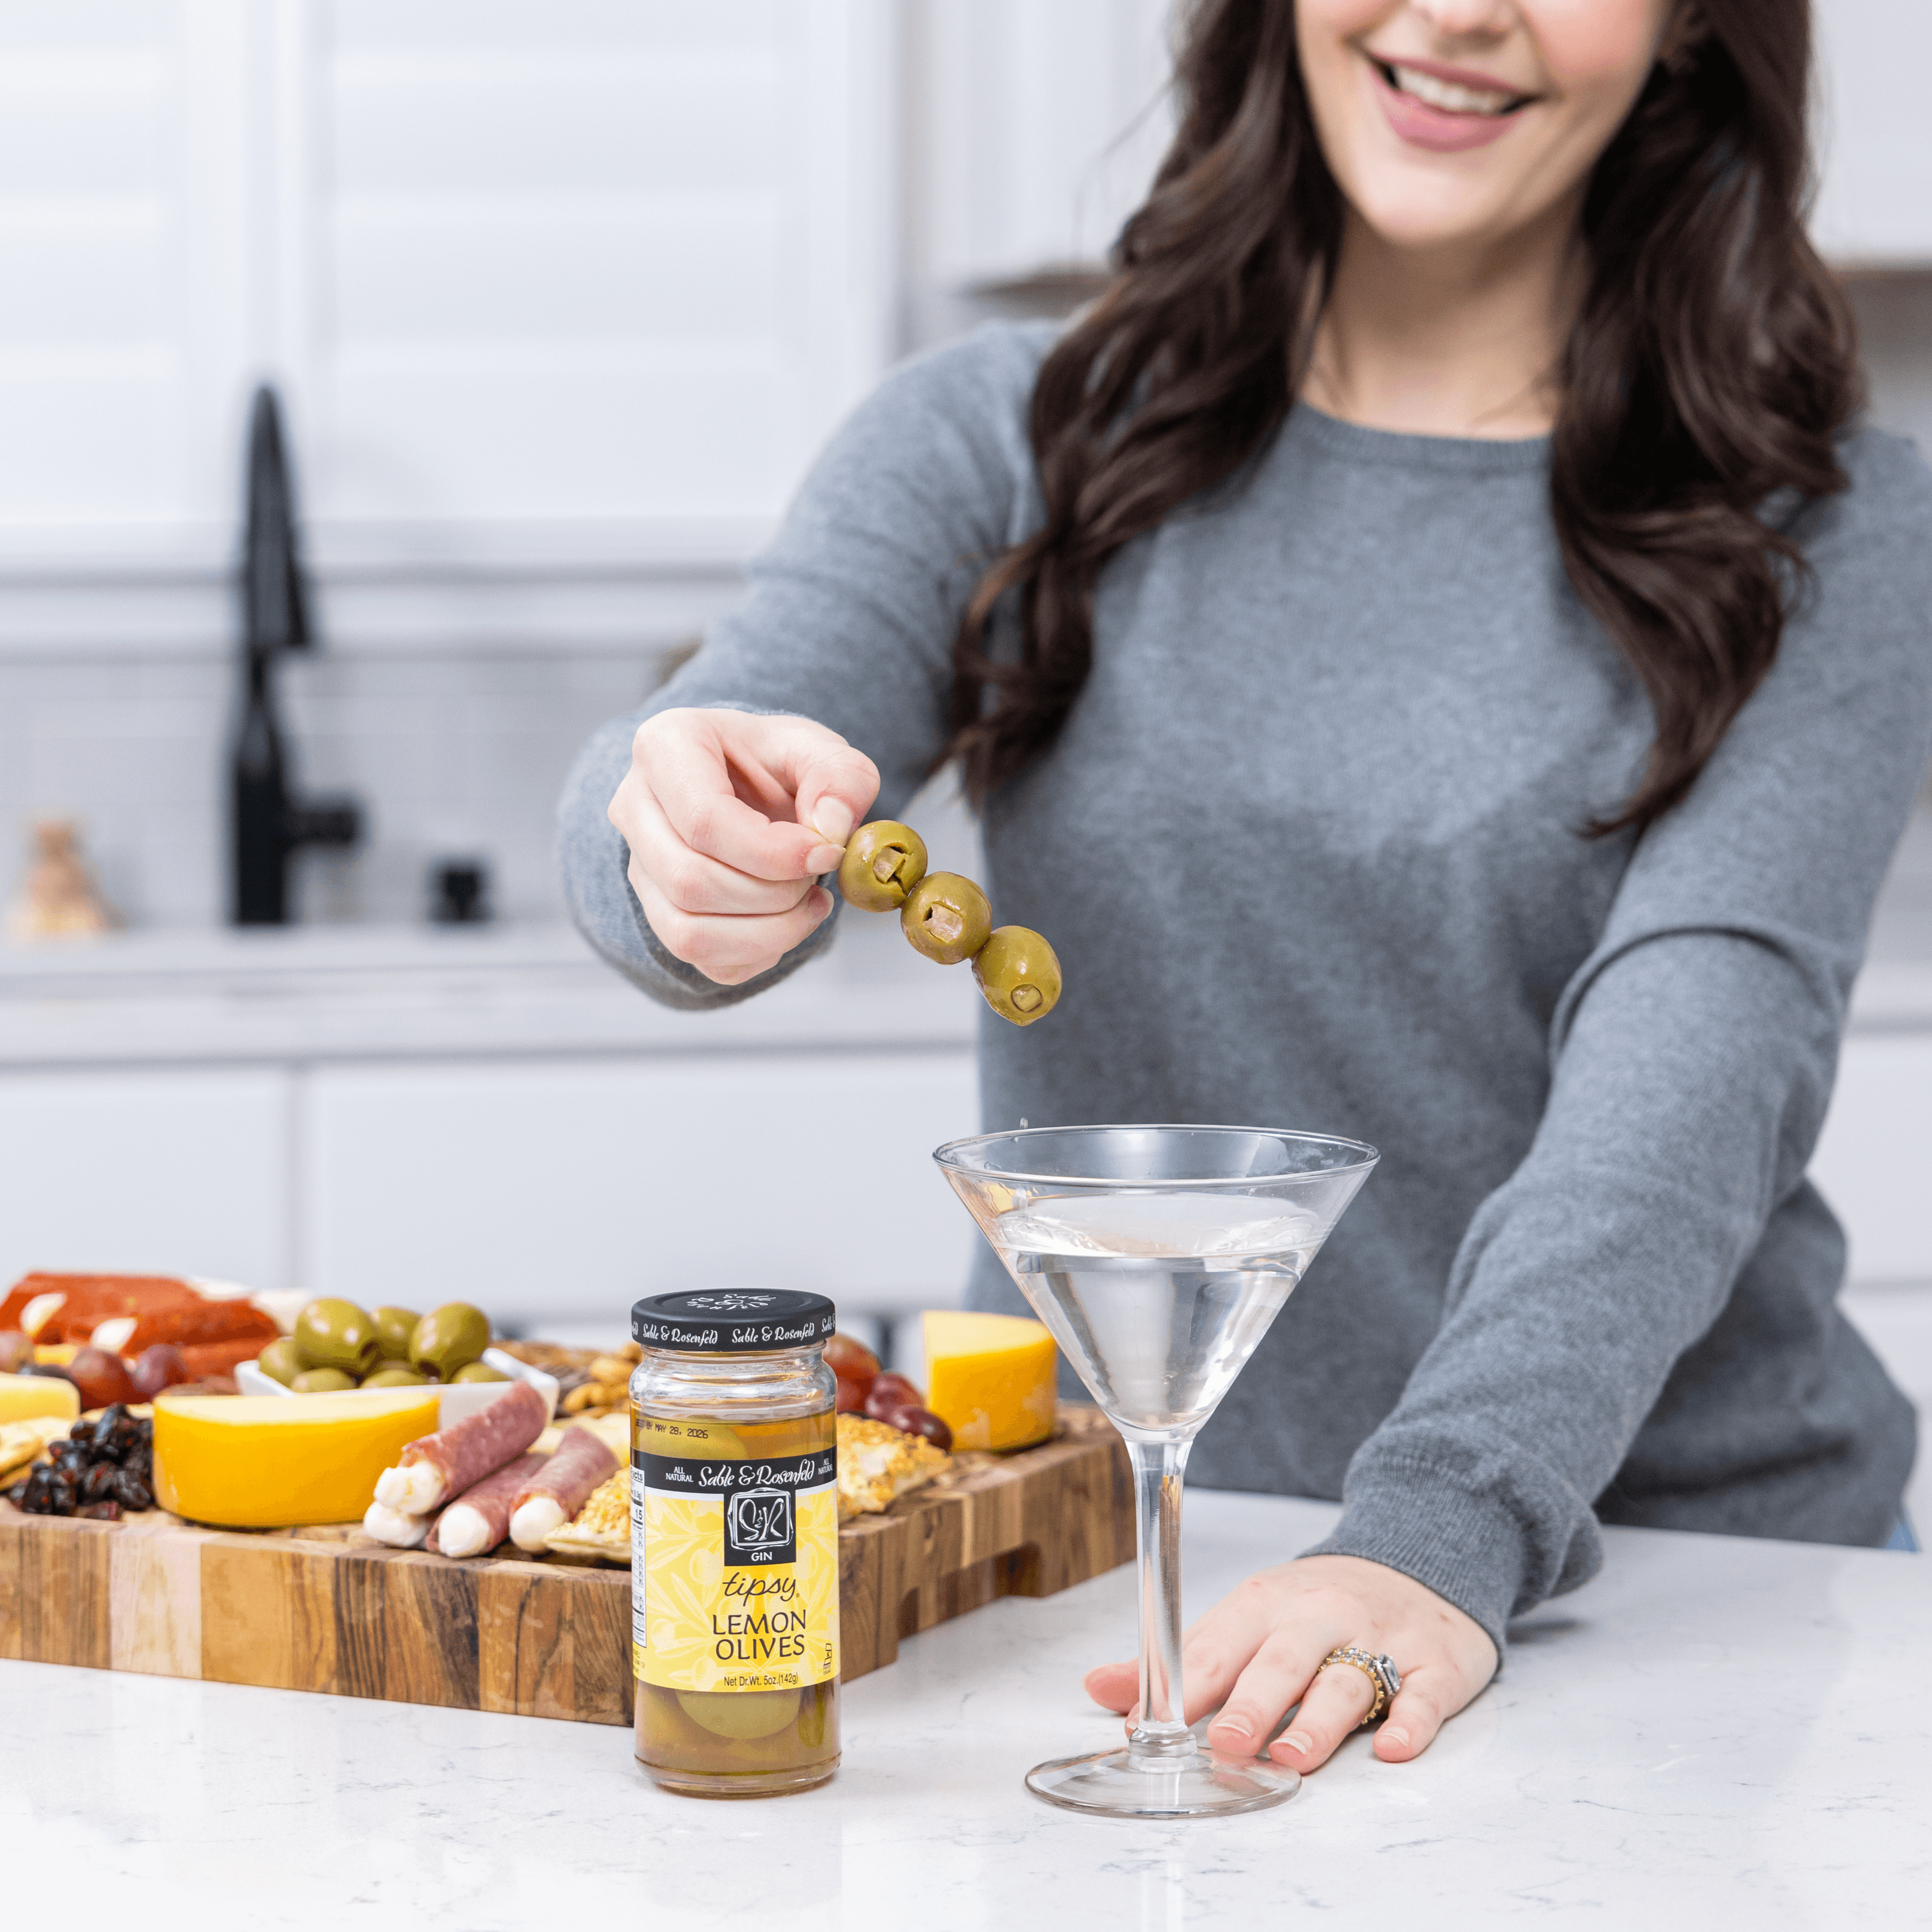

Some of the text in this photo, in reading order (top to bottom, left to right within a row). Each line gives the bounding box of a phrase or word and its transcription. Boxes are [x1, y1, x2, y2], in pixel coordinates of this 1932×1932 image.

[643, 1323, 659, 1340] Sable
[661, 1325, 670, 1341] &
[671, 1328, 718, 1347] Rosenfeld
[732, 1322, 815, 1343] Sable & Rosenfeld
[670, 1426, 681, 1435] 28,
[687, 1428, 708, 1439] 2026
[665, 1473, 694, 1482] NATURAL
[698, 1459, 815, 1487] Sable & Rosenfeld
[751, 1551, 773, 1562] GIN
[722, 1571, 797, 1607] tipsy
[712, 1609, 806, 1634] LEMON
[715, 1634, 805, 1660] OLIVES
[724, 1676, 737, 1686] Net
